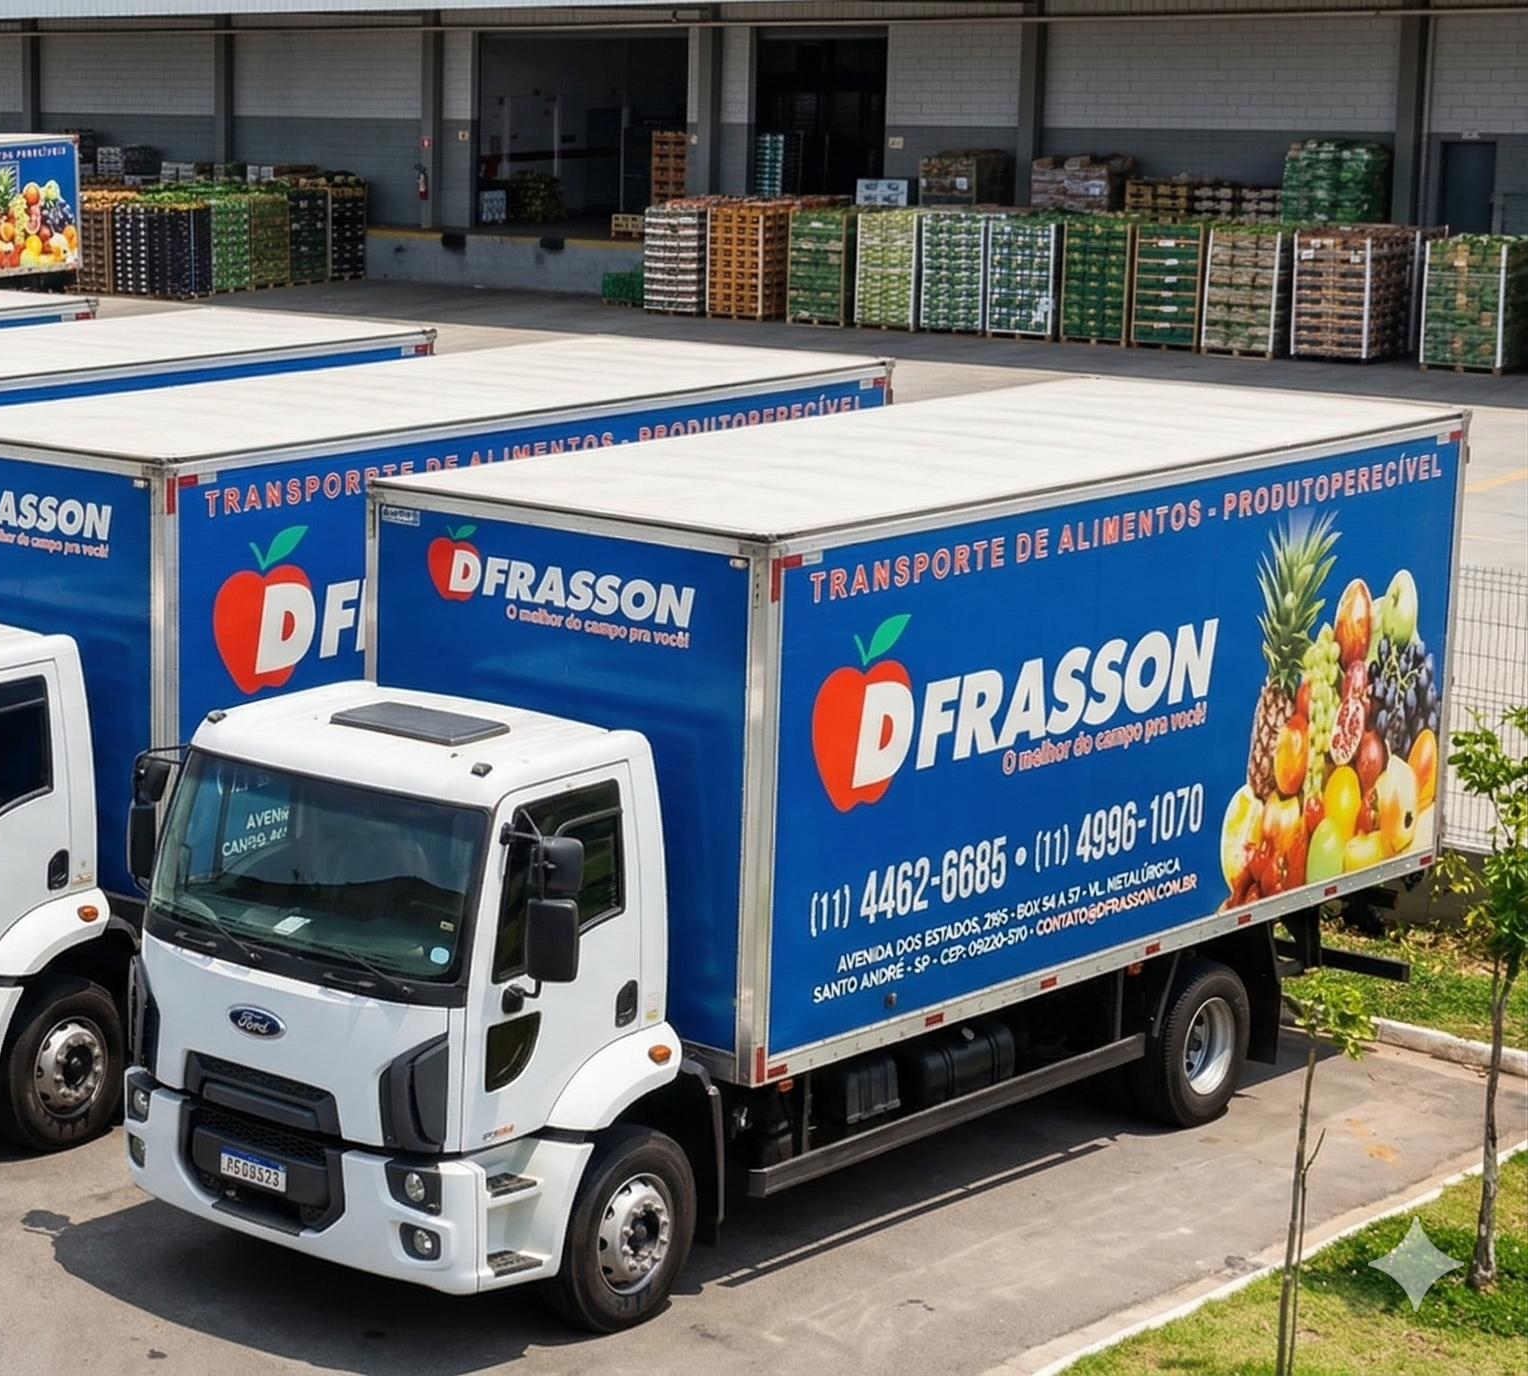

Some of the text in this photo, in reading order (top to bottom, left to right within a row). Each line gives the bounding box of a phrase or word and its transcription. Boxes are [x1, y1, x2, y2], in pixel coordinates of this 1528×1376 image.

[810, 537, 1005, 604] TRANSPORTE
[1015, 528, 1050, 563] DE
[1057, 499, 1202, 554] ALIMENTOS
[1223, 453, 1442, 521] PRODUTOPERECÍVEL
[448, 548, 696, 628] DFRASSON
[506, 603, 517, 620] O
[565, 612, 582, 631] do
[584, 619, 628, 640] campo
[629, 626, 651, 643] pra
[851, 617, 1220, 790] DFRASSON
[1002, 749, 1016, 775] O
[1018, 738, 1072, 771] melhor
[1073, 730, 1093, 757] do
[1095, 721, 1143, 749] campo
[1144, 715, 1168, 743] pra
[810, 884, 851, 938] (11)
[859, 835, 1008, 925] 4462-6685
[1034, 823, 1070, 873] (11)
[1076, 783, 1204, 864] 4996-1070
[896, 933, 923, 954] DOS
[1016, 898, 1041, 921] BOX
[813, 978, 858, 1004] SANTO
[860, 957, 905, 991] ANDRÉ
[914, 955, 931, 974] SP
[238, 1011, 271, 1034] Ford
